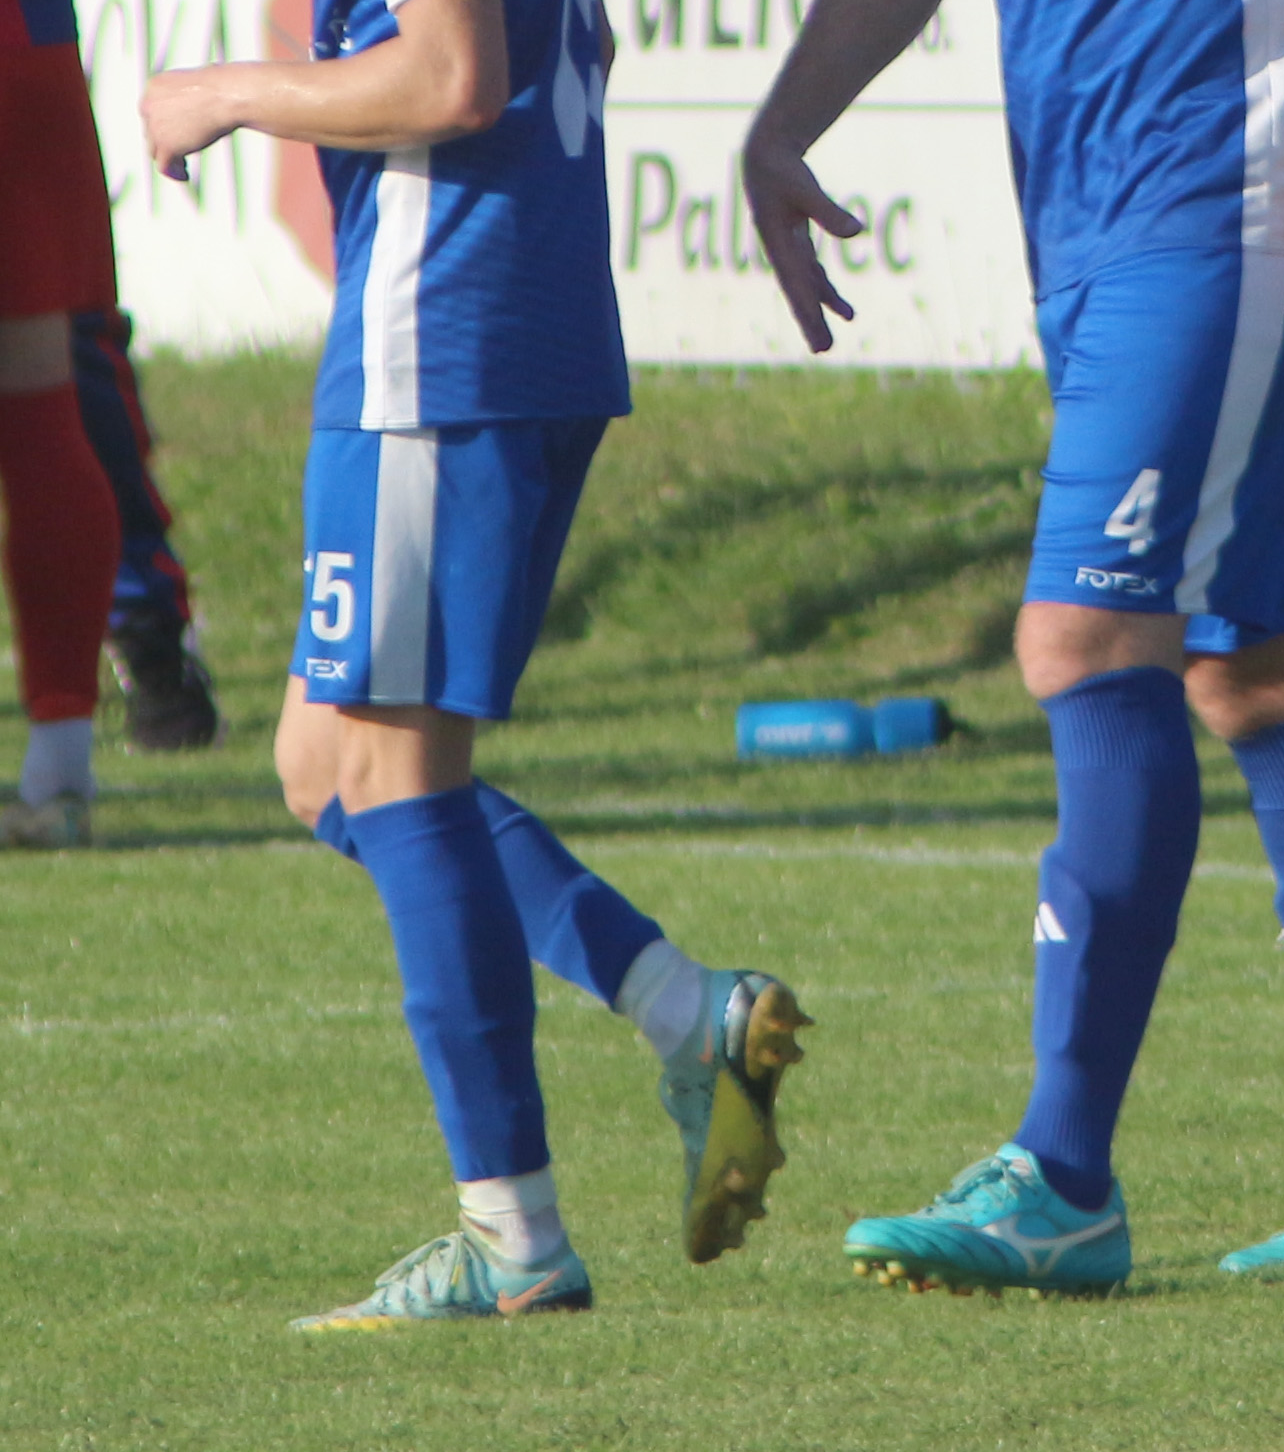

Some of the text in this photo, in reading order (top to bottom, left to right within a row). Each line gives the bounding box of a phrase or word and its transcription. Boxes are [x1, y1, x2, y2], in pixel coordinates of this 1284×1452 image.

[622, 149, 915, 273] Palec
[1104, 468, 1160, 556] 4
[304, 551, 354, 641] 5
[1075, 566, 1157, 594] FOTEX
